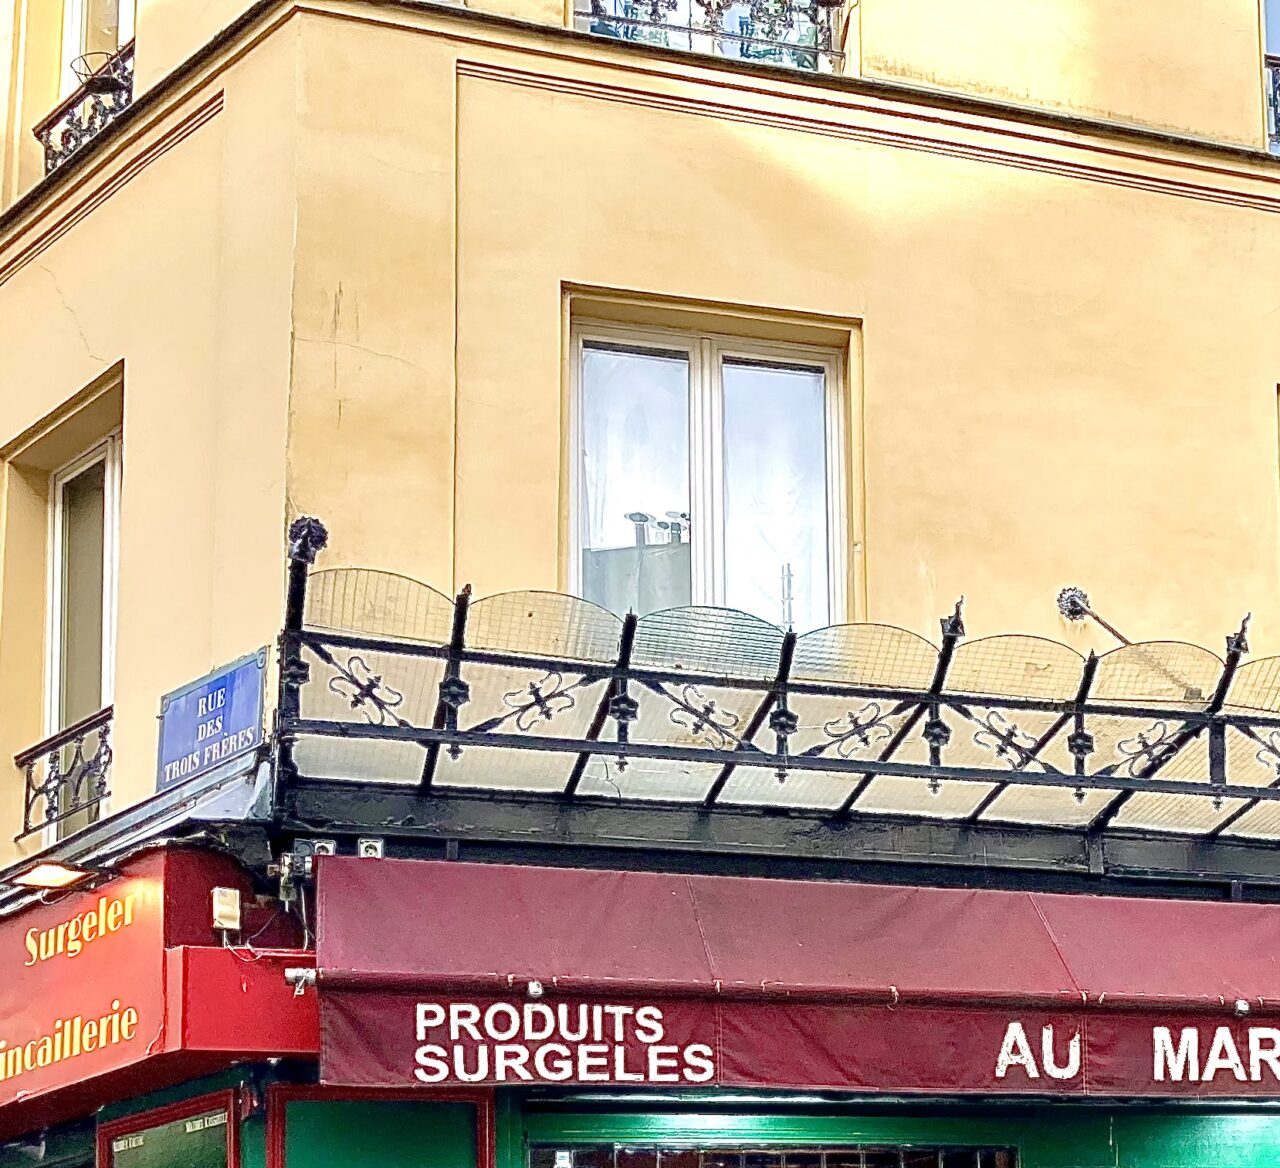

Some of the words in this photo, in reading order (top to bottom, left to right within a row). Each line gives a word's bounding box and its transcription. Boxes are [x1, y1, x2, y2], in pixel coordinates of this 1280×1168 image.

[198, 688, 226, 717] RUE
[198, 716, 223, 741] DES
[164, 751, 200, 782] TROIS
[203, 726, 254, 765] FRÈRES
[0, 999, 138, 1081] incaillerie
[415, 1003, 665, 1043] PRODUITS
[413, 1043, 716, 1084] SURGELES
[995, 1022, 1082, 1079] AU
